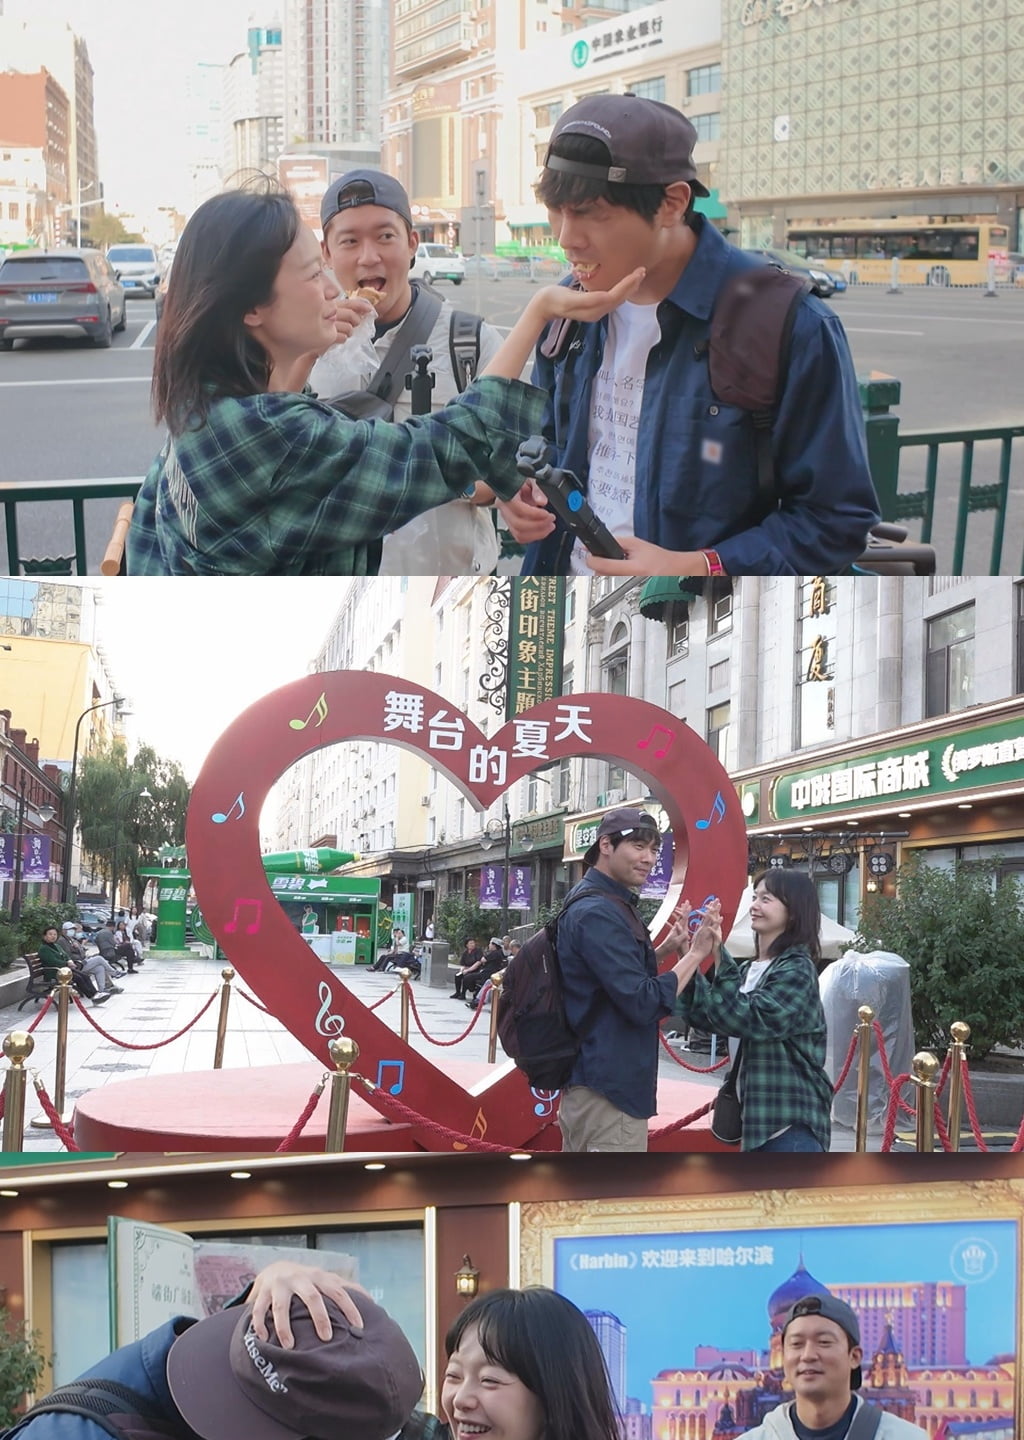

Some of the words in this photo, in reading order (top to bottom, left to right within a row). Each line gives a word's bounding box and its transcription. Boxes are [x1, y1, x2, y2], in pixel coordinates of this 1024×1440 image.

[591, 16, 663, 51] 中国农业银行
[546, 609, 556, 645] THEME
[384, 690, 593, 786] 舞台的夏天
[790, 751, 931, 810] 中俄国际商城
[641, 1245, 774, 1269] 欢迎来到哈尔滨
